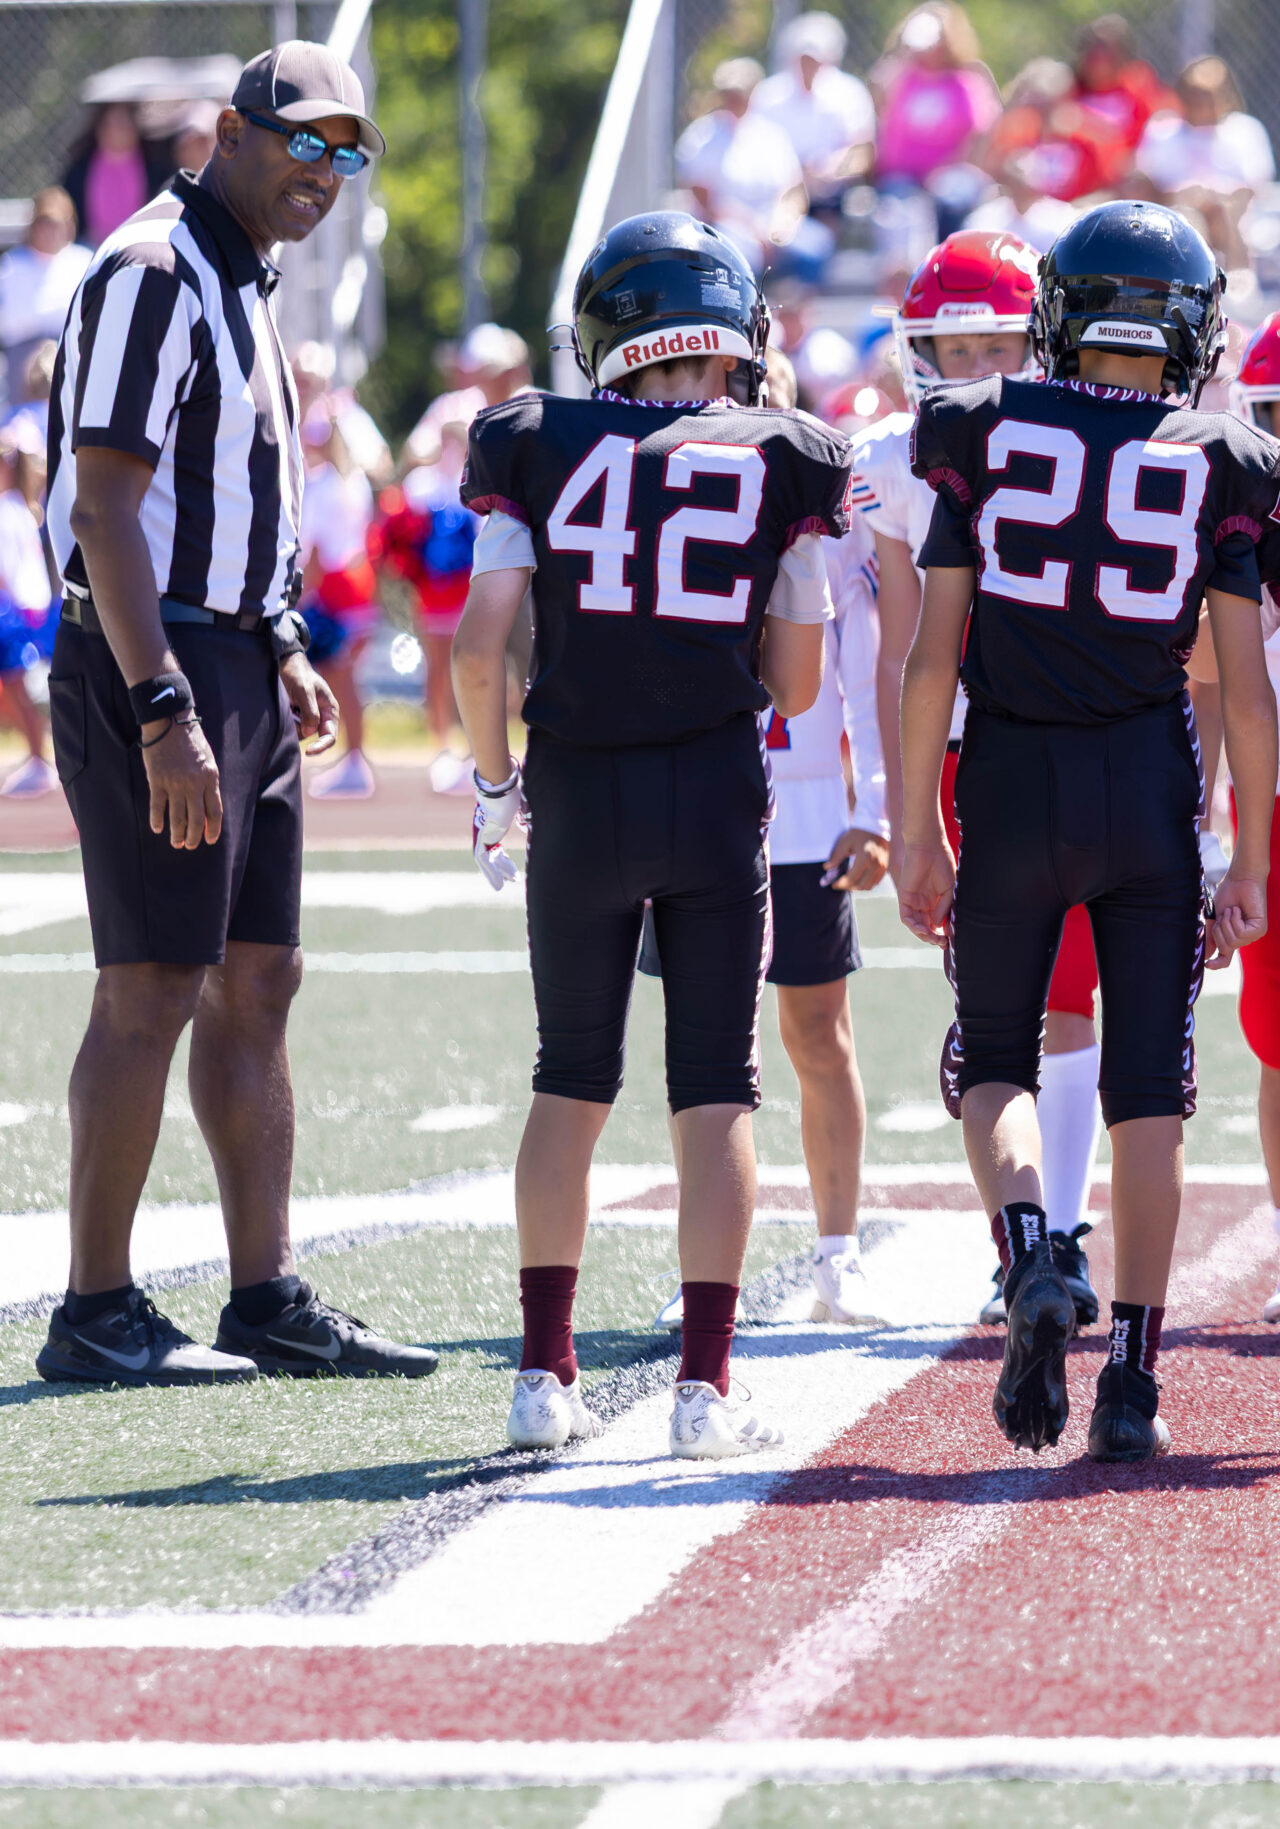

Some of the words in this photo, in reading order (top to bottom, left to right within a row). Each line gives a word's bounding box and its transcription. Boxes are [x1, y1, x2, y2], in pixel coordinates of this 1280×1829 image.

[622, 330, 720, 367] Riddell
[1098, 326, 1153, 340] MUDHOGS
[547, 433, 768, 624] 42
[973, 418, 1213, 622] 29
